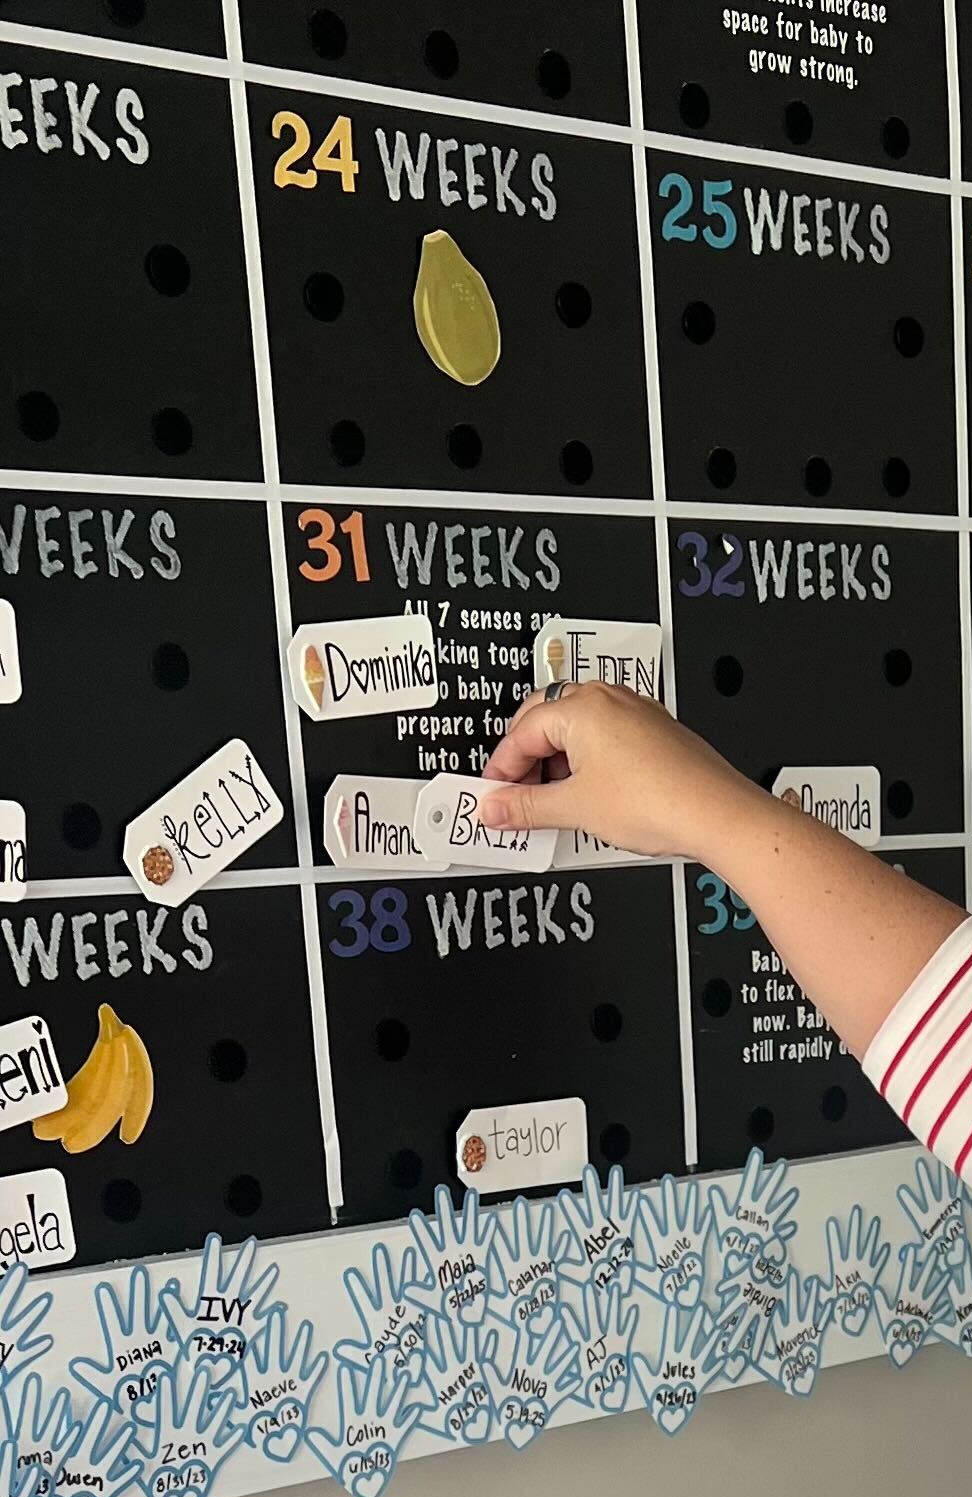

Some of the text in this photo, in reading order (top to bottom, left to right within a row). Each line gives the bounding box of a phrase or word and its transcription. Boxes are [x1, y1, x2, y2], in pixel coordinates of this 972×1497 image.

[820, 0, 887, 23] increase
[723, 9, 873, 54] space for baby to
[750, 50, 858, 89] grow strong.
[0, 72, 149, 165] EEKS
[271, 110, 557, 221] 24 WEEKS
[658, 173, 890, 265] 25 WEEKS
[299, 508, 560, 591] 31 WEEKS
[676, 531, 891, 603] 32 WEEKS
[438, 602, 450, 628] 7
[461, 608, 522, 631] senses
[433, 637, 534, 670] king toge
[438, 675, 531, 704] o baby ca
[397, 713, 474, 740] prepare
[418, 745, 490, 771] into th
[354, 791, 423, 855] Aman
[328, 881, 595, 960] 38 WEEKS
[1, 903, 214, 987] WEEKS
[741, 983, 757, 1003] to
[765, 979, 794, 1002] flex
[753, 1012, 790, 1033] now.
[743, 1039, 773, 1063] still
[780, 1037, 832, 1063] rapidly
[488, 1117, 567, 1160] taylor
[735, 1205, 770, 1232] Callan
[583, 1216, 620, 1264] Abel
[438, 1253, 476, 1291] Maia
[449, 1278, 487, 1309] 5/22/25
[197, 1296, 251, 1326] IVY
[586, 1335, 607, 1370] AJ
[776, 1323, 824, 1362] Maverick
[438, 1362, 476, 1405] Harper
[511, 1368, 548, 1399] Nova
[662, 1361, 696, 1380] Jules
[347, 1424, 386, 1446] Colin
[162, 1442, 207, 1465] Zen
[156, 1473, 207, 1492] 8/31/23
